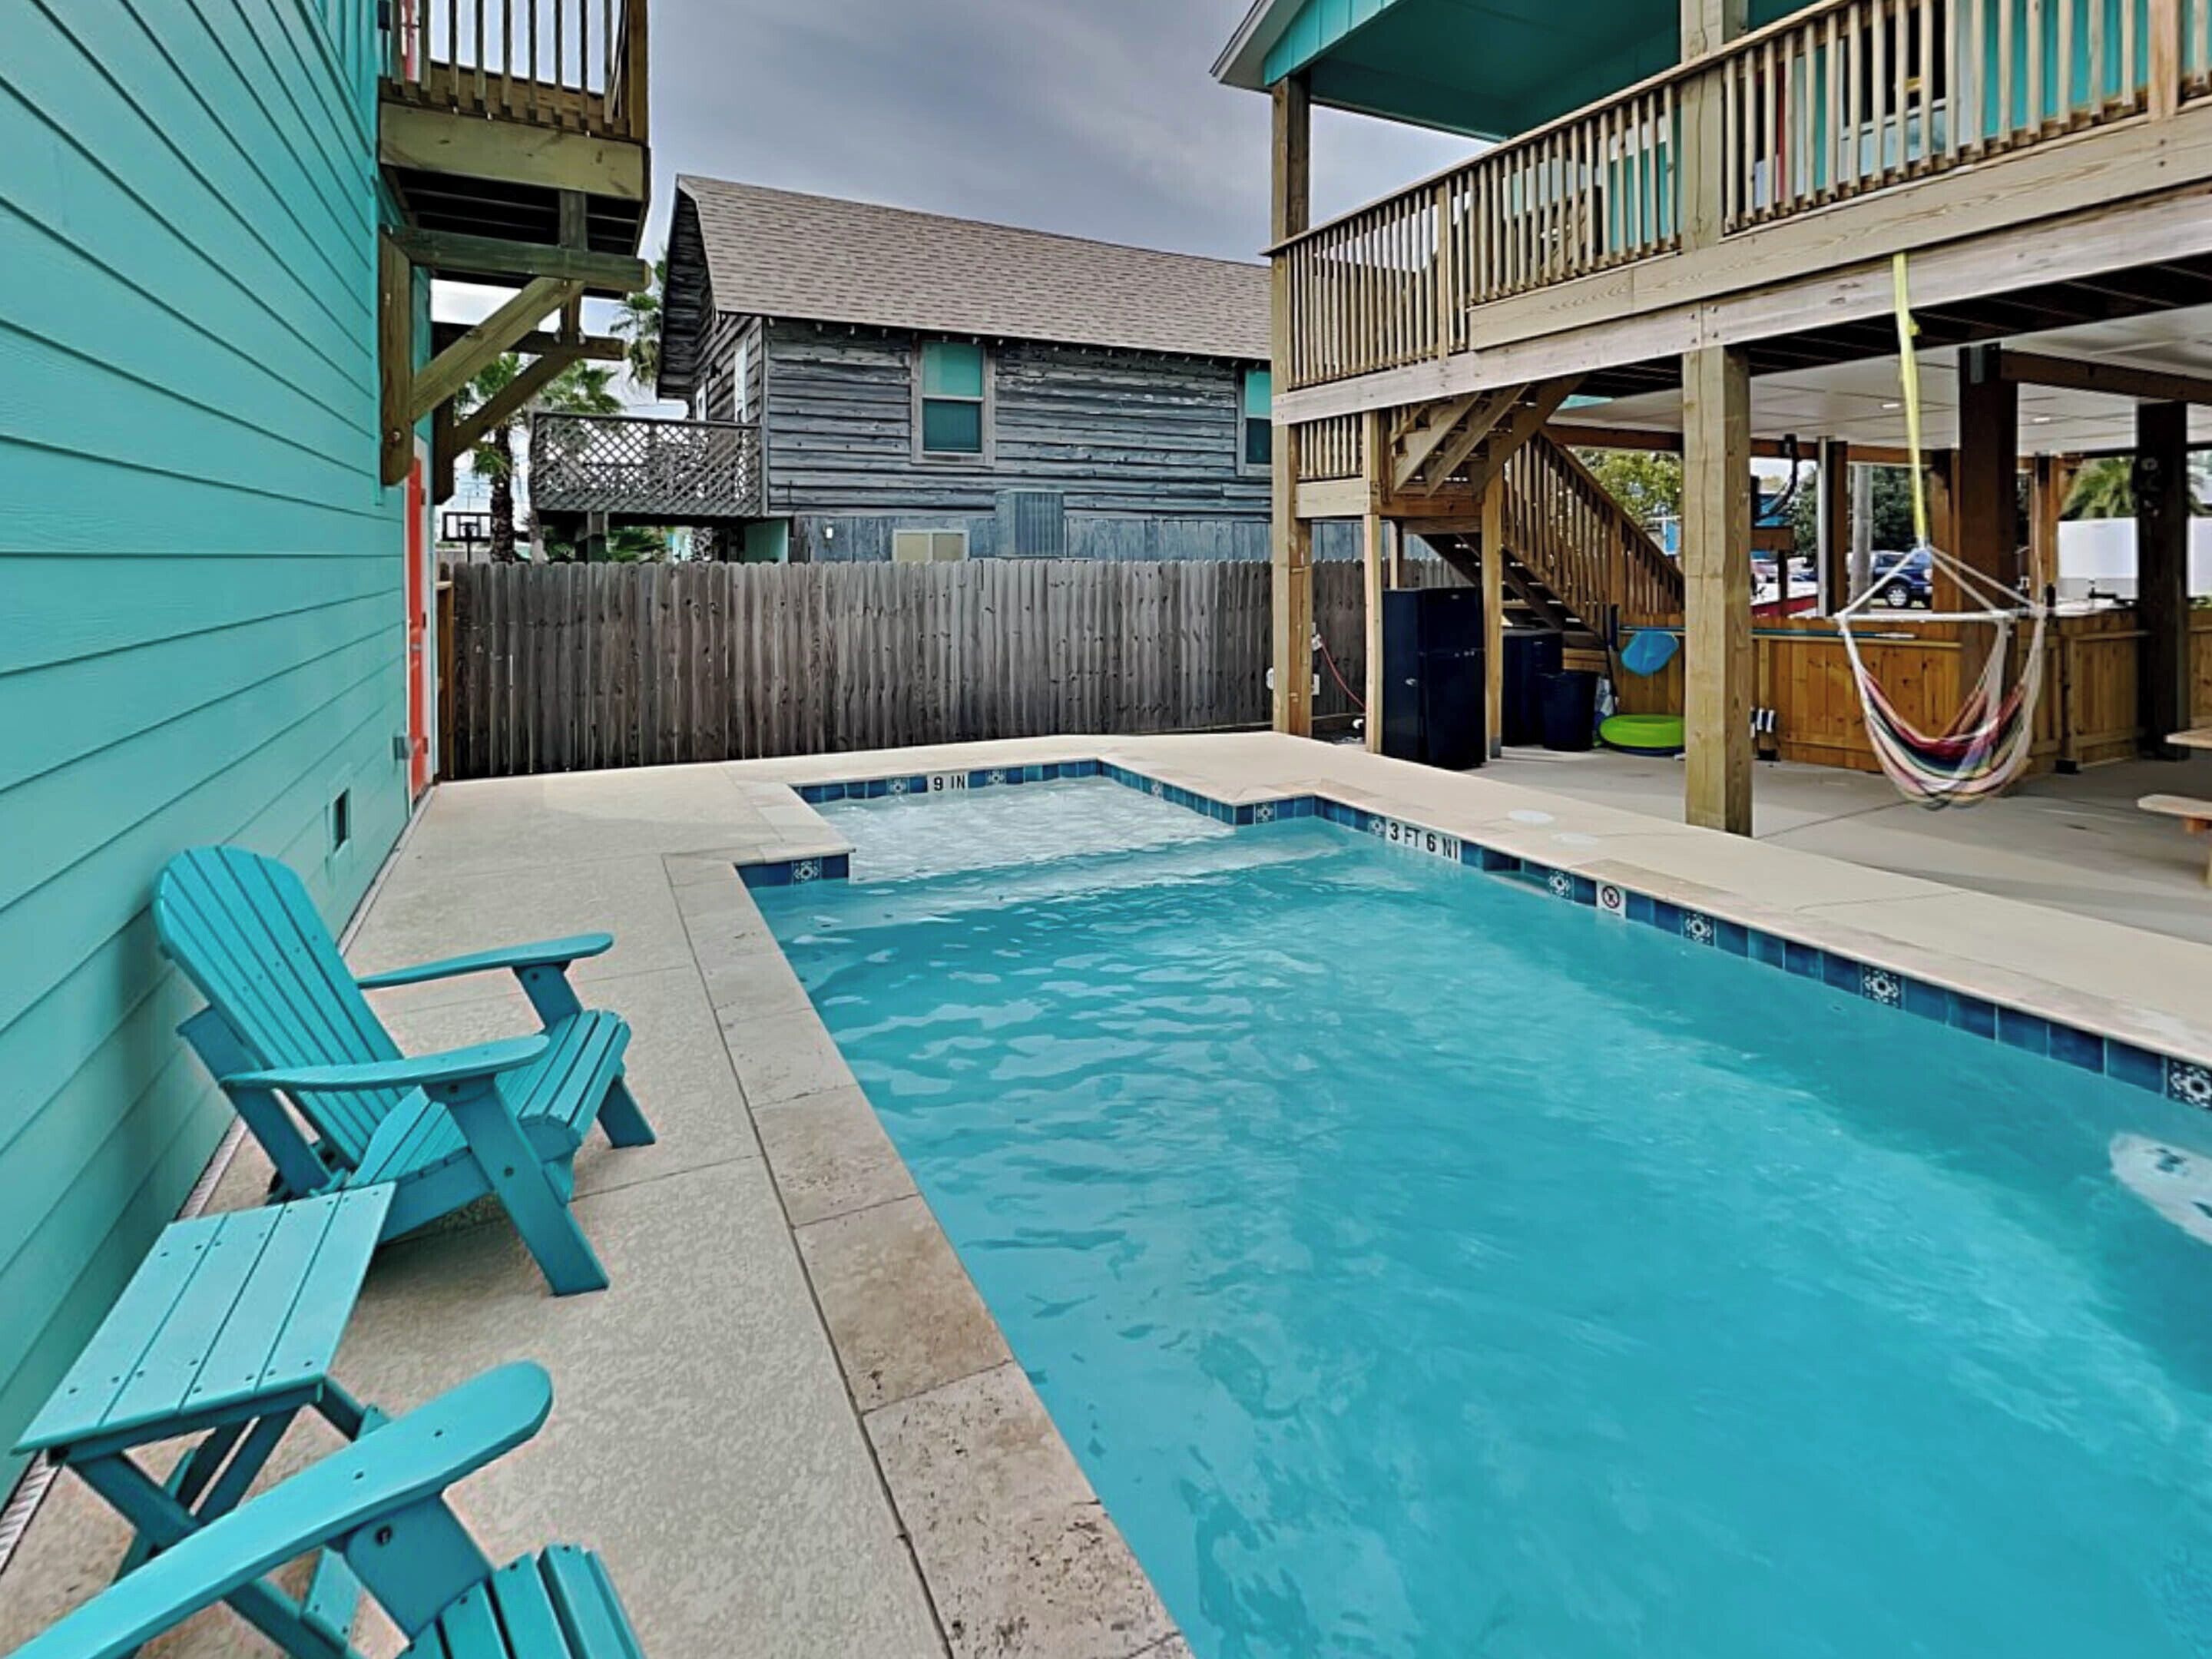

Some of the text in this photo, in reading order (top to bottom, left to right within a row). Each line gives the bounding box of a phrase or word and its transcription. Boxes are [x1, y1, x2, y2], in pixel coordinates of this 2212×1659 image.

[934, 774, 965, 791] 9 IN
[1389, 823, 1399, 841] 3
[1404, 826, 1421, 847] FT
[1426, 833, 1436, 853] 6
